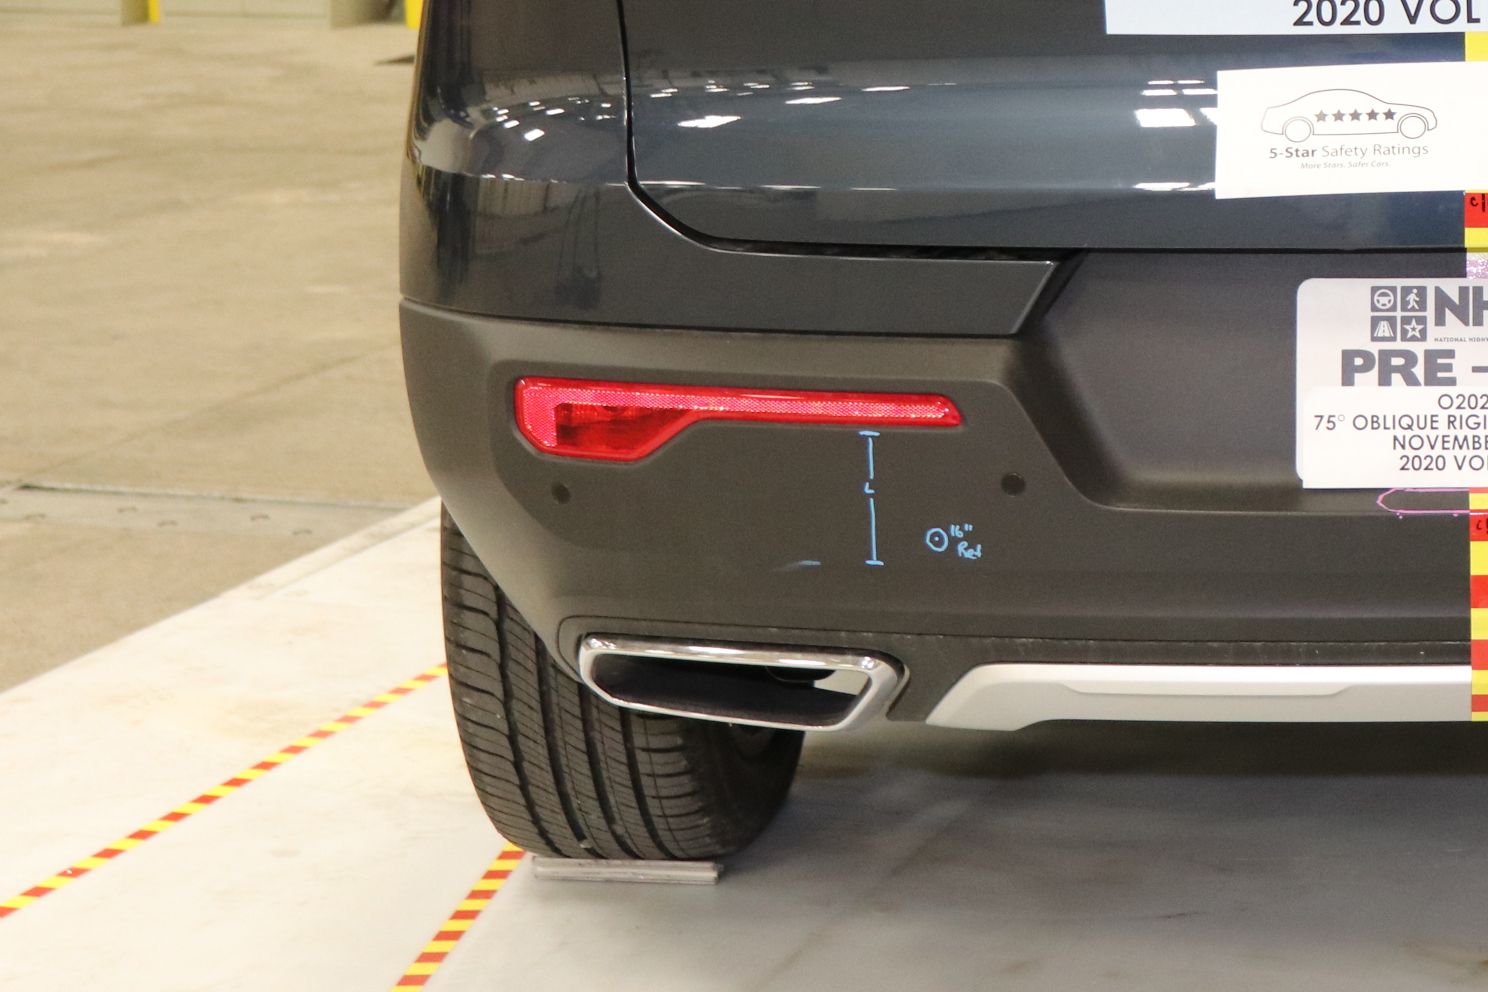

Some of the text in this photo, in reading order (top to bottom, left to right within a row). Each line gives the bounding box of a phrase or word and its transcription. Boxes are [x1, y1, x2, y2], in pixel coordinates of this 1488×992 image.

[1269, 143, 1429, 159] 5-Star Safety Ratings
[1323, 161, 1346, 169] Stars.
[1370, 160, 1391, 168] Cars.
[1341, 348, 1457, 387] PRE
[1313, 413, 1346, 432] 75°
[1352, 414, 1439, 432] OBLIQUE
[1399, 454, 1446, 472] 2020
